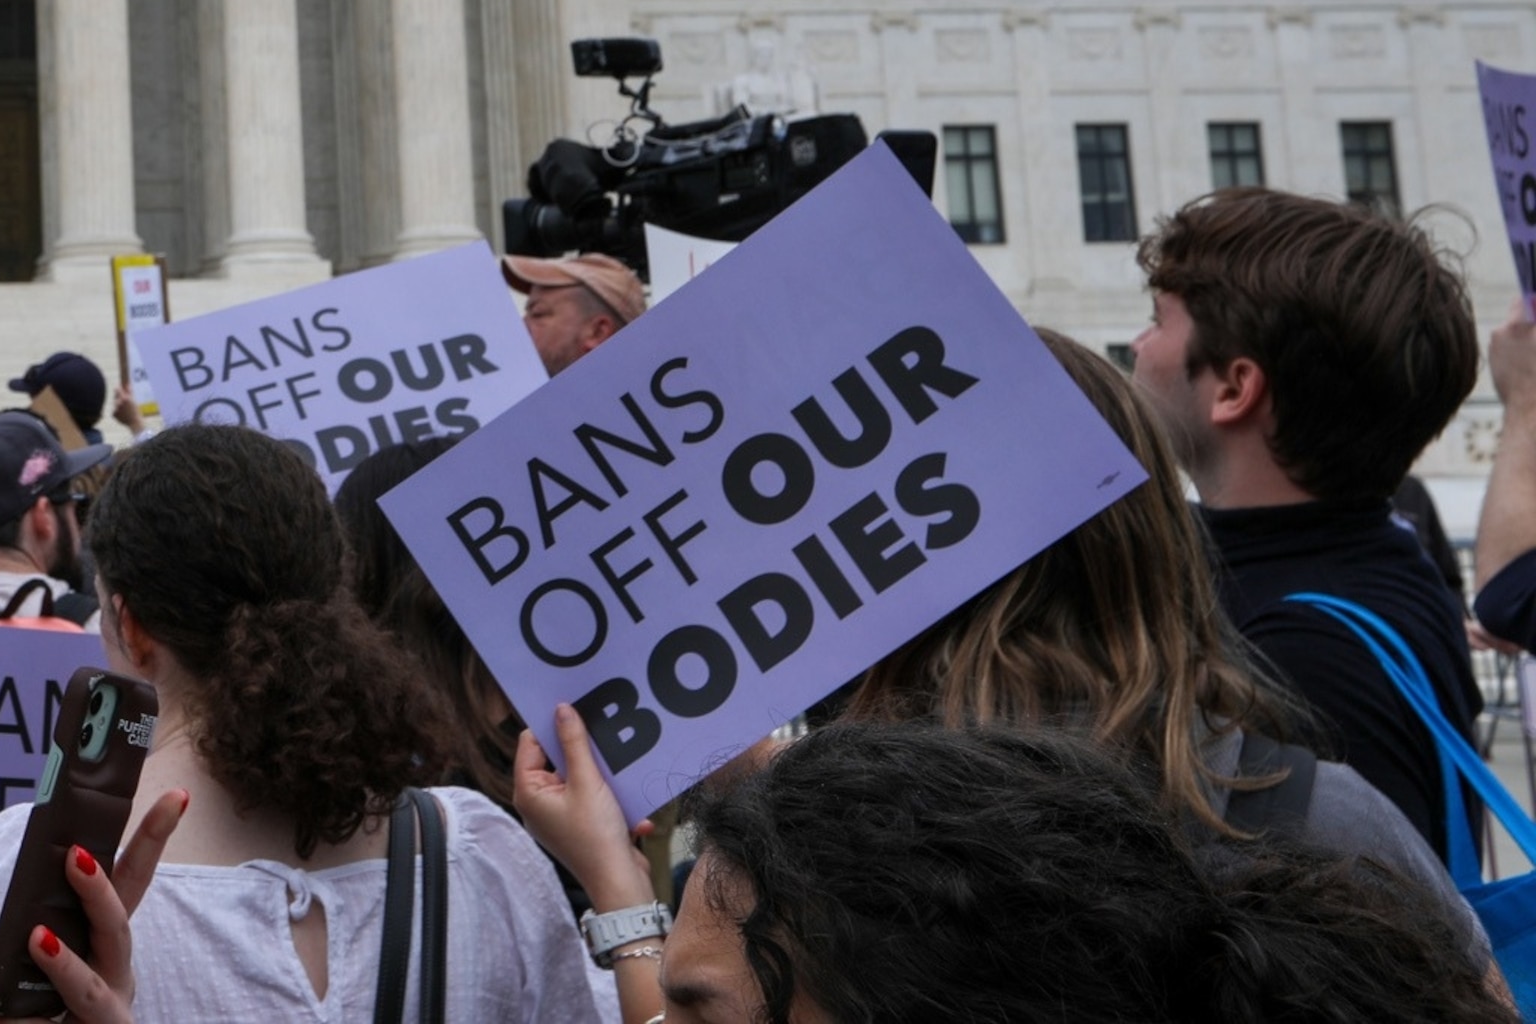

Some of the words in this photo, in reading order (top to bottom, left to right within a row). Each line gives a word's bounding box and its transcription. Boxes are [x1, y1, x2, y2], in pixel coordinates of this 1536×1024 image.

[169, 308, 351, 392] BANS
[337, 333, 500, 403] OUR
[281, 397, 480, 474] DIES
[446, 356, 725, 585] BANS
[519, 489, 707, 667] OFF
[721, 325, 980, 525] OUR
[570, 452, 980, 775] BODIES
